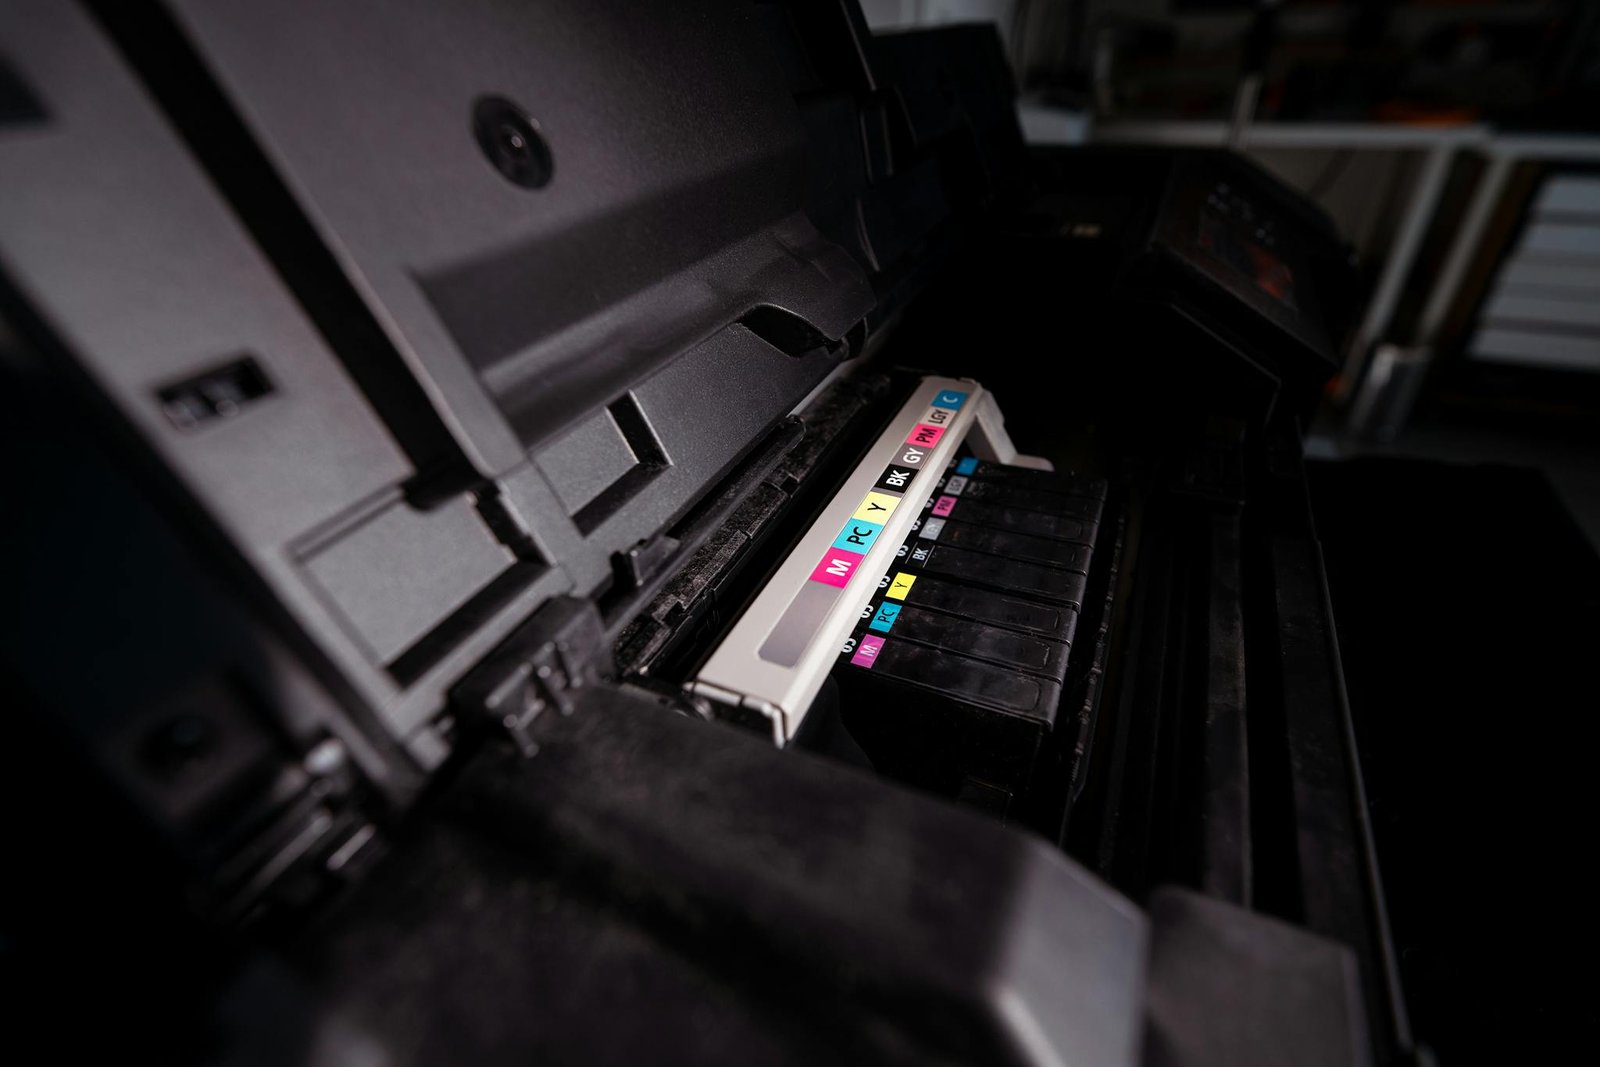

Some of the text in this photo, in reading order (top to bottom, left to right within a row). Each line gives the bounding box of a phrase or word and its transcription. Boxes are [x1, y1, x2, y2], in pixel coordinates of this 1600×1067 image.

[942, 395, 959, 404] C
[928, 410, 948, 424] LGY
[915, 428, 938, 443] PM
[903, 447, 924, 464] GY
[886, 469, 911, 487] BK
[868, 502, 886, 513] Y
[846, 526, 873, 545] PC
[912, 548, 929, 561] BK
[825, 558, 852, 577] M
[894, 581, 908, 589] Y
[878, 609, 895, 624] PC
[860, 644, 878, 657] M
